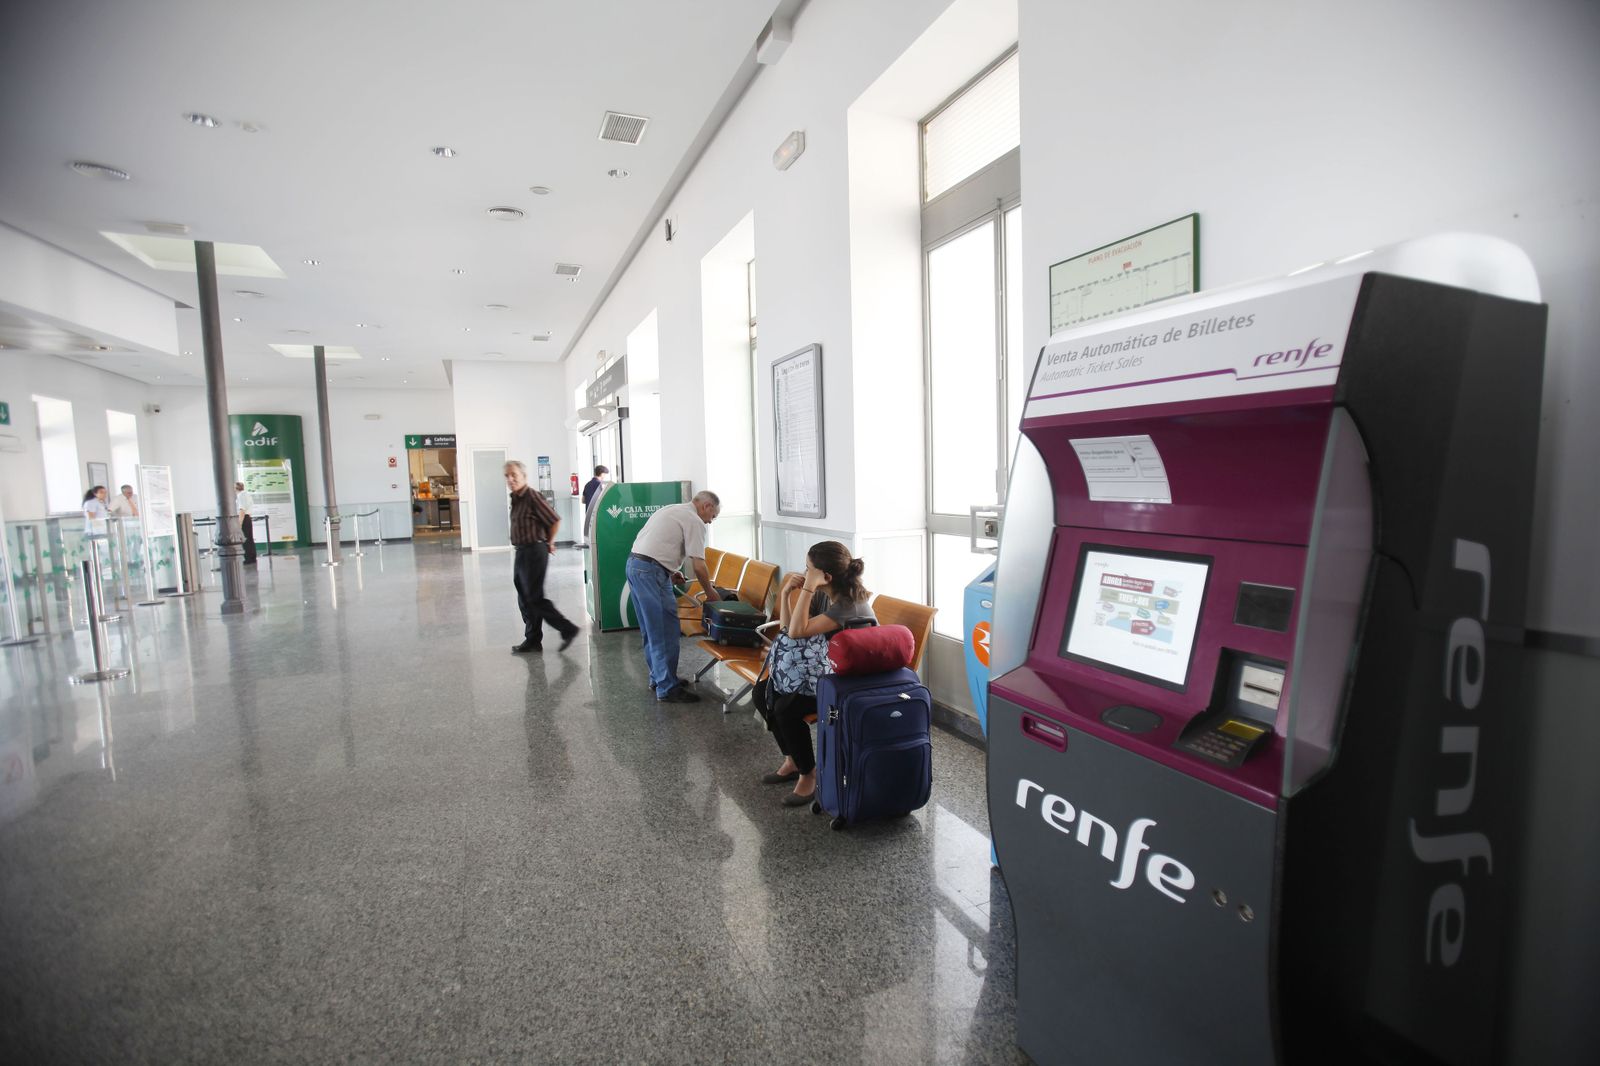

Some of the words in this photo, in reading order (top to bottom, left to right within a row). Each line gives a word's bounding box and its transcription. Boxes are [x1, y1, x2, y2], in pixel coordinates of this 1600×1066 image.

[1047, 350, 1079, 366] Venta
[1080, 333, 1158, 359] Automática
[1162, 327, 1182, 344] de
[1187, 313, 1255, 339] Billetes
[1253, 337, 1334, 369] renfe
[1039, 366, 1084, 382] Automatic
[1086, 361, 1115, 375] Ticket
[1115, 355, 1145, 370] Sales
[244, 437, 279, 447] adif
[1409, 538, 1493, 968] renfe
[1015, 778, 1196, 904] renfe
